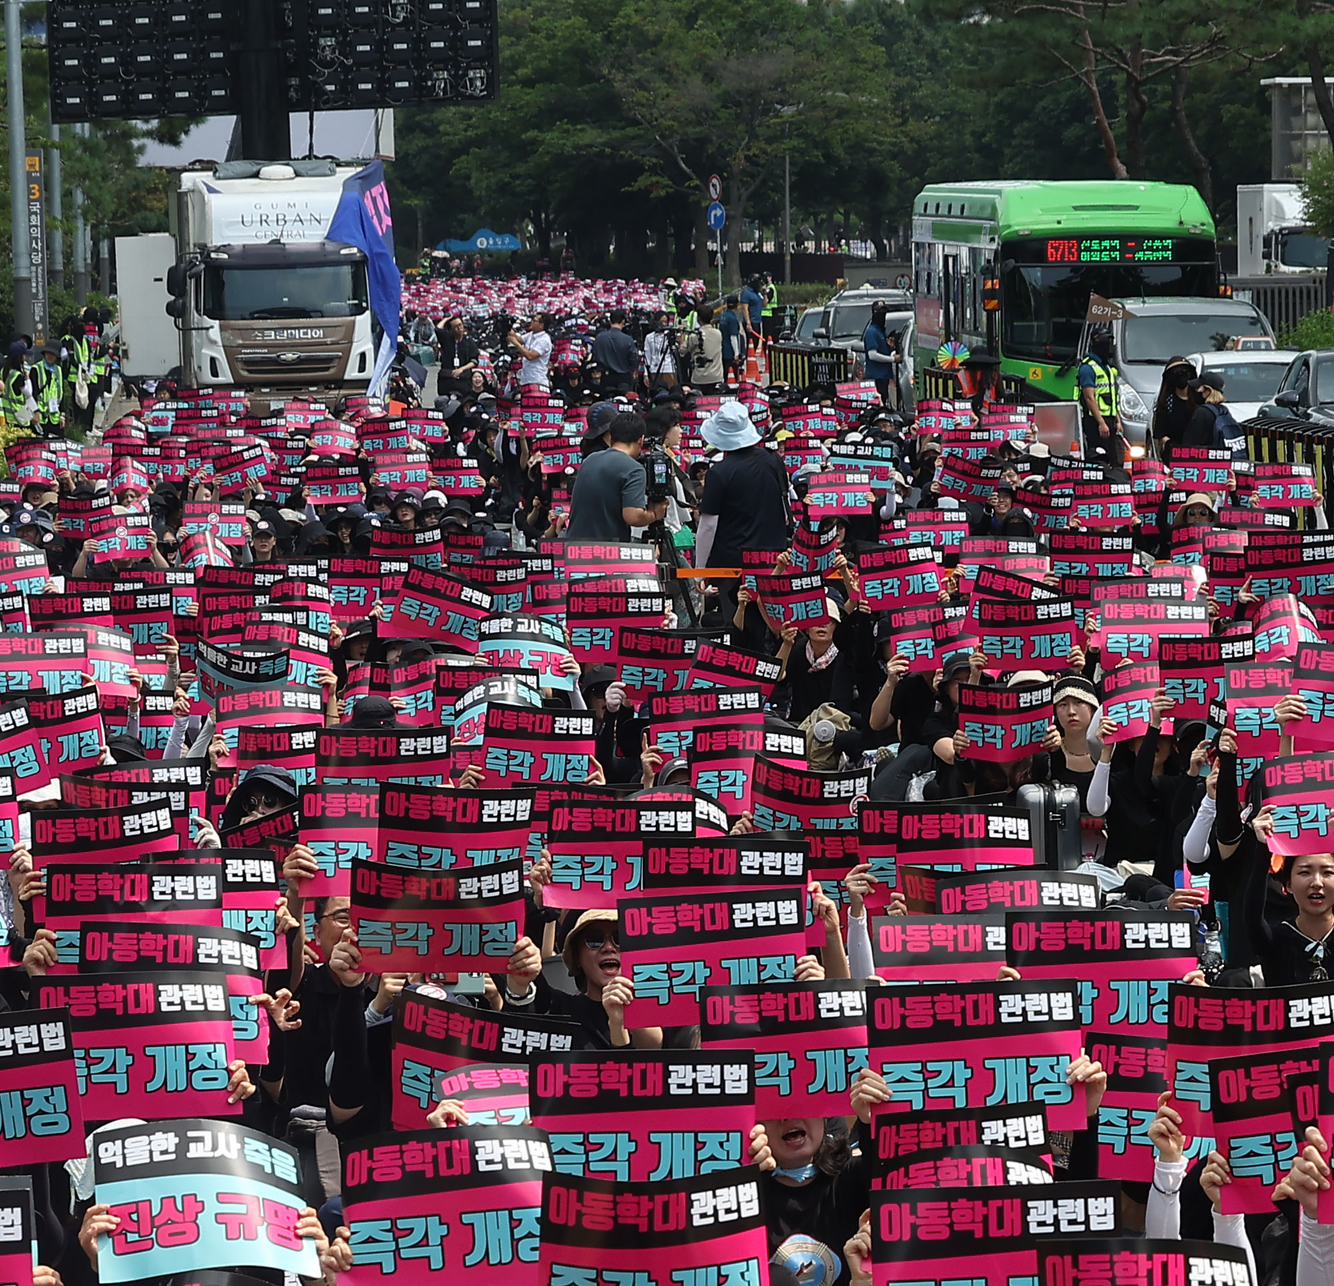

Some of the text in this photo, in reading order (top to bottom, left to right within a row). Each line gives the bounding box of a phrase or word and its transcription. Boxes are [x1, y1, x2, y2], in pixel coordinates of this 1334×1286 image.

[29, 184, 41, 199] 3
[241, 213, 322, 227] URBAN
[29, 201, 43, 265] 국회의사당
[255, 230, 307, 239] CENTRAL
[1047, 240, 1078, 261] 6713
[1091, 305, 1123, 318] 62기-3
[251, 329, 324, 340] 스크린미디어
[376, 454, 426, 465] 아동학대 관련법
[1172, 448, 1231, 459] 아동학대 관련법
[378, 468, 426, 483] 즉각 개정
[1174, 468, 1228, 483] 즉각 개정
[860, 547, 933, 567] 아동학대 관련법
[865, 573, 939, 599] 즉각 개정
[98, 1131, 298, 1184] 억울한 교사 죽음
[549, 1182, 759, 1231] 아동학대 관련법
[107, 1191, 304, 1256] 진상 규명
